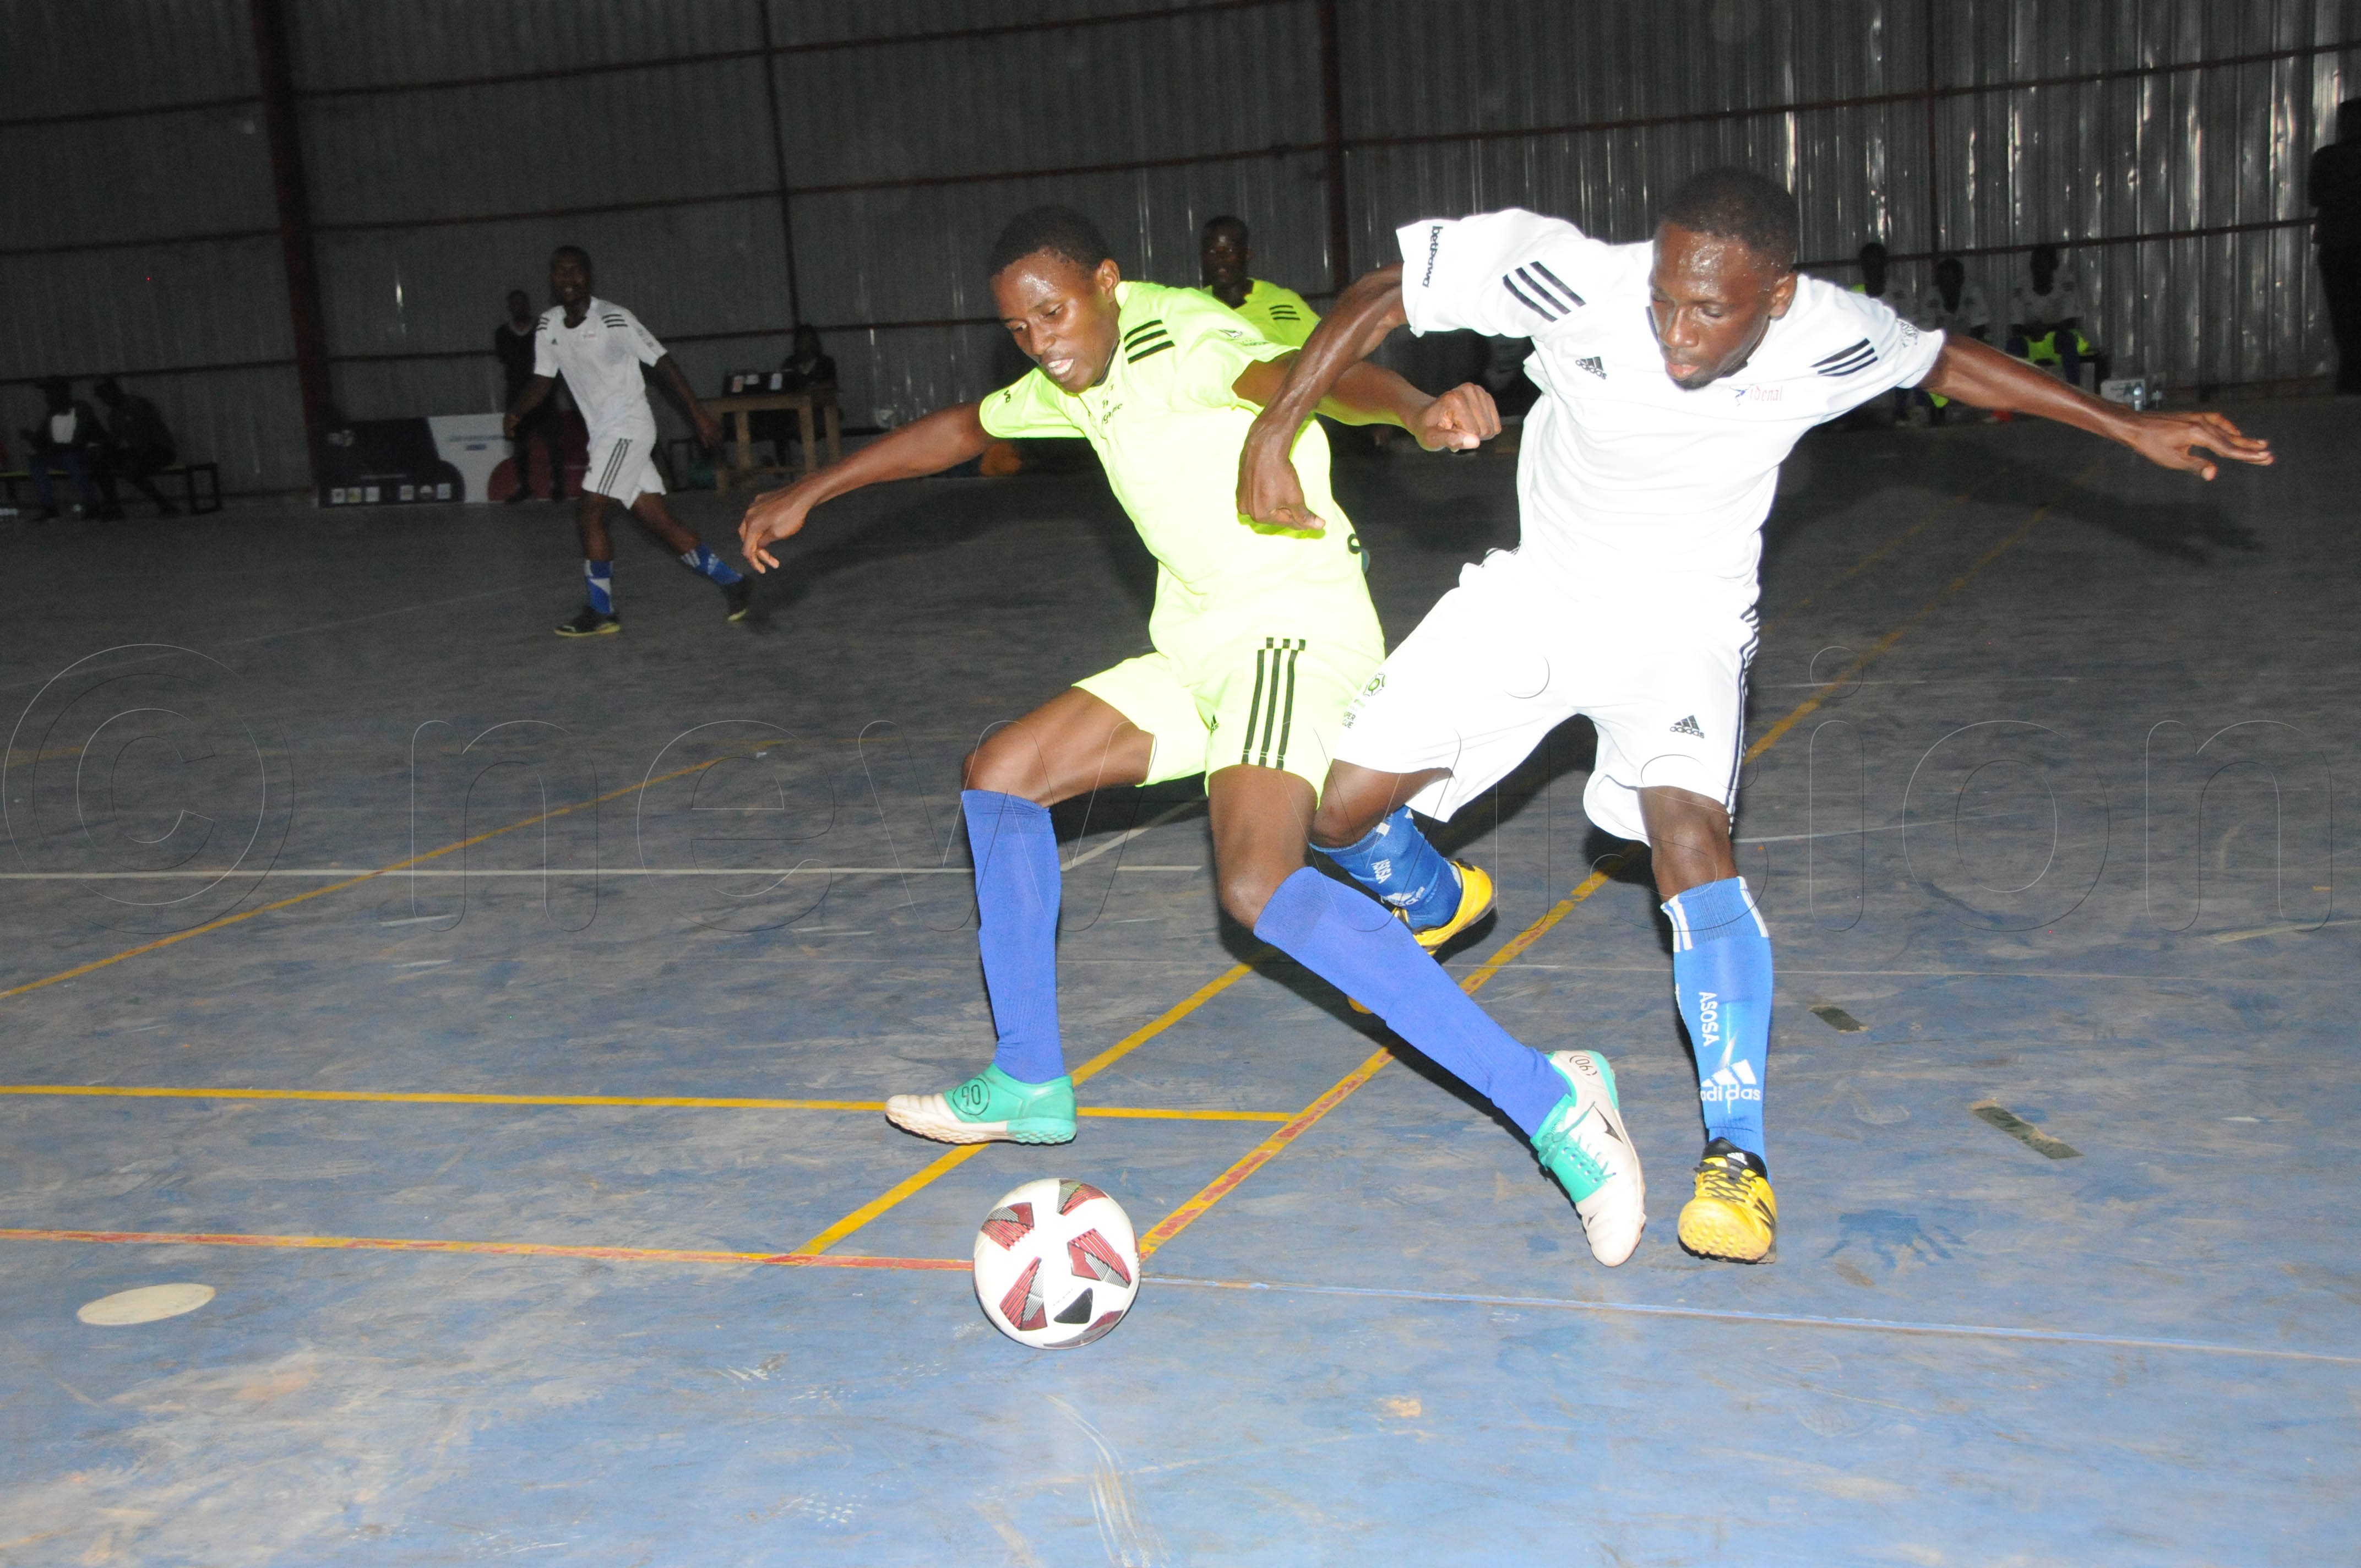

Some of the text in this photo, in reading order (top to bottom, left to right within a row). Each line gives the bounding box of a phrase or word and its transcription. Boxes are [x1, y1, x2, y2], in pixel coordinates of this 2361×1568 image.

[1575, 360, 1607, 380] adidas
[1669, 726, 1705, 738] adidas
[1699, 992, 1720, 1047] ASOSA
[962, 1085, 981, 1107] 90
[1700, 1085, 1761, 1102] adidas
